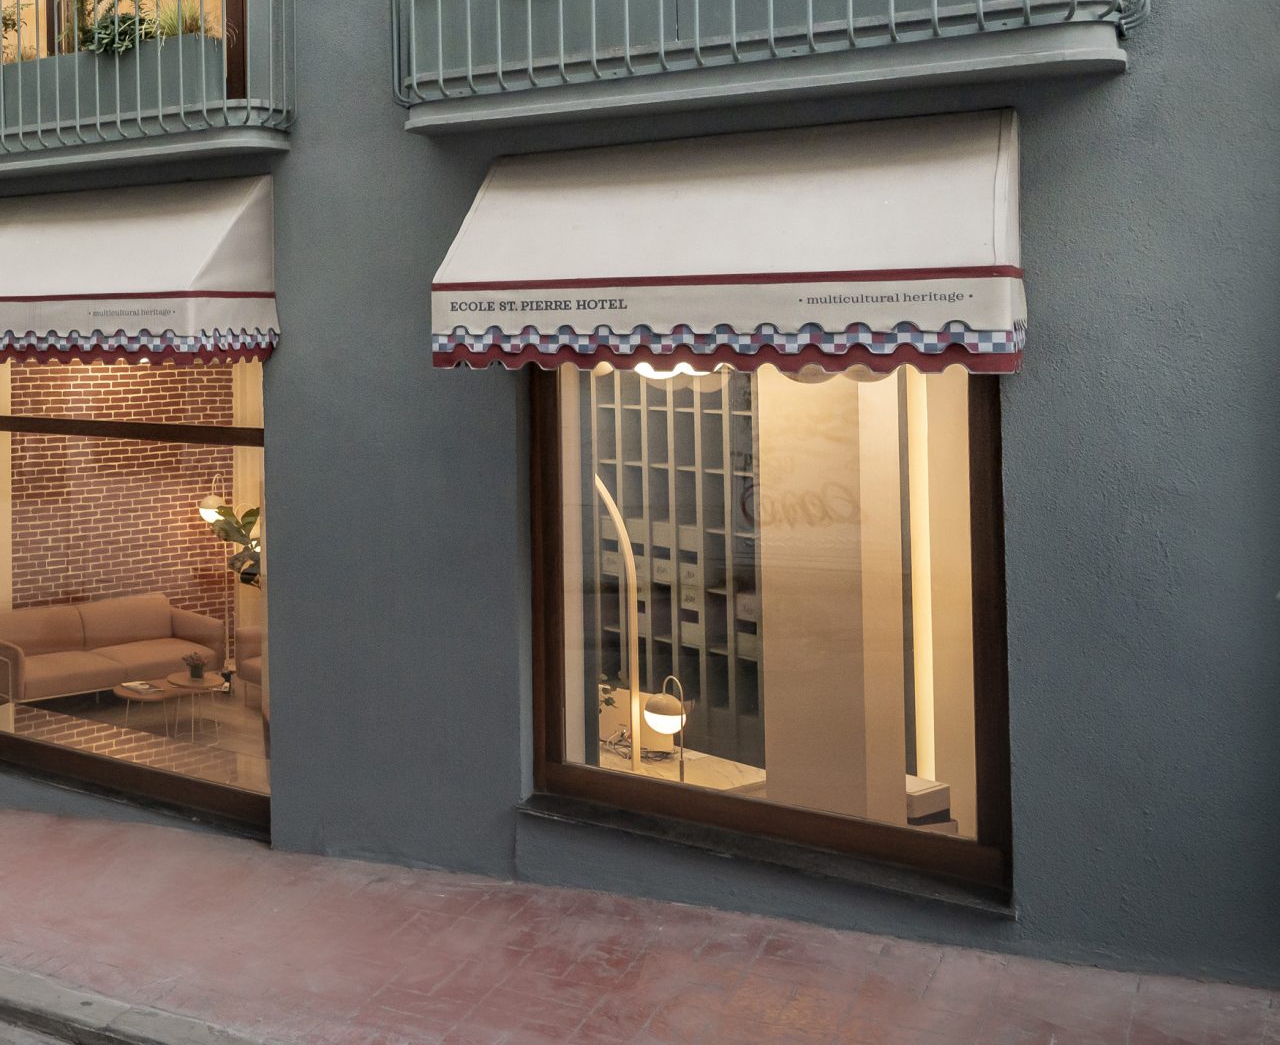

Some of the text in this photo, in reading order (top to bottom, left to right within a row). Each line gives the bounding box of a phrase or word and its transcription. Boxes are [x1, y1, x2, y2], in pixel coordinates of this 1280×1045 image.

[450, 298, 628, 312] ECOLE ST. PIERRE HOTEL
[806, 291, 965, 305] multicultural heritage
